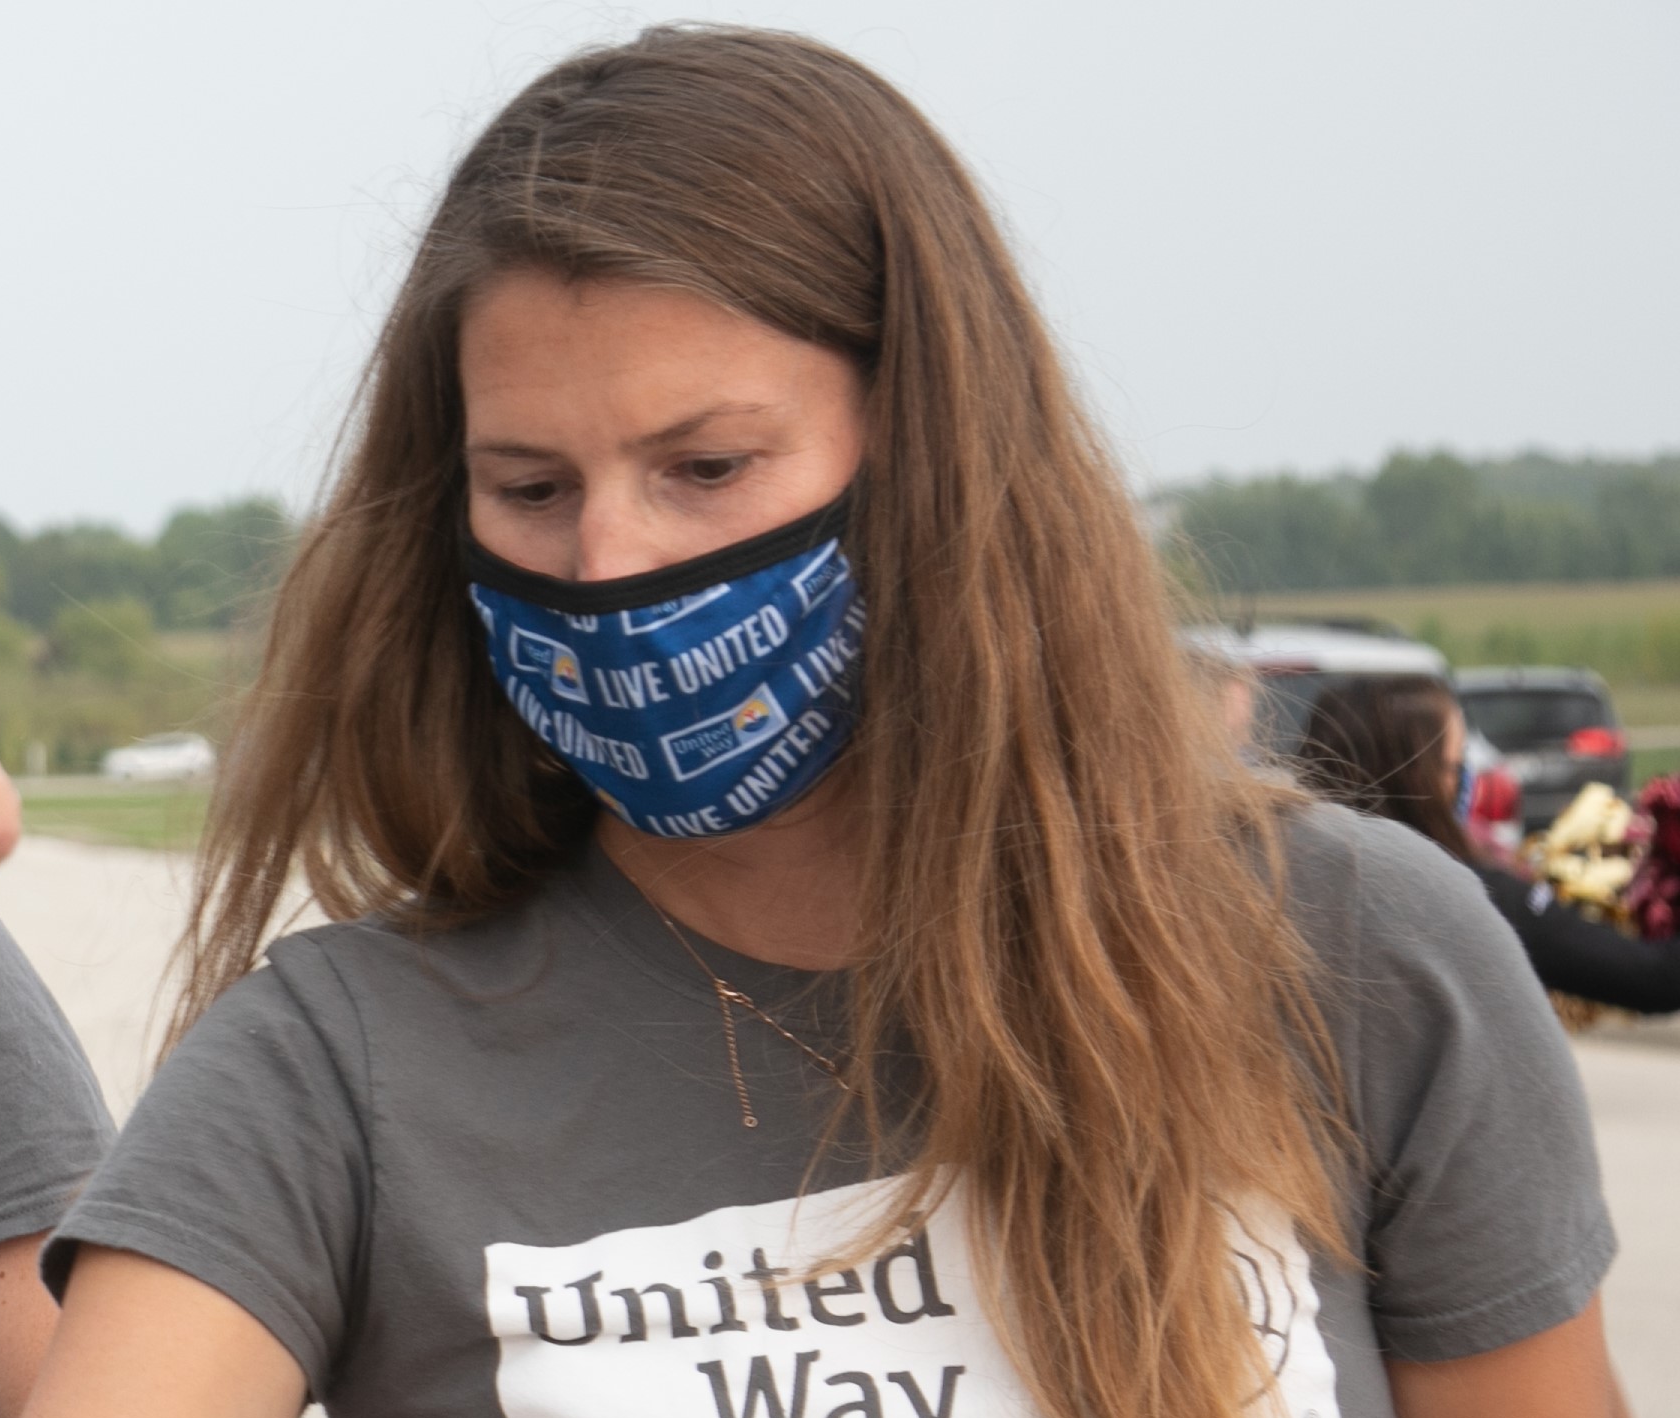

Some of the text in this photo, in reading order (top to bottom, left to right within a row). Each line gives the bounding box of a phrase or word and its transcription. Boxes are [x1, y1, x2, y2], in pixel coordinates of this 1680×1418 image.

[595, 661, 670, 709] LIVE
[670, 604, 790, 694] UNITED
[552, 712, 650, 781] UNITED
[647, 708, 834, 838] LIVE UNITED
[672, 720, 734, 755] United
[698, 735, 736, 760] Way
[515, 1224, 955, 1347] United
